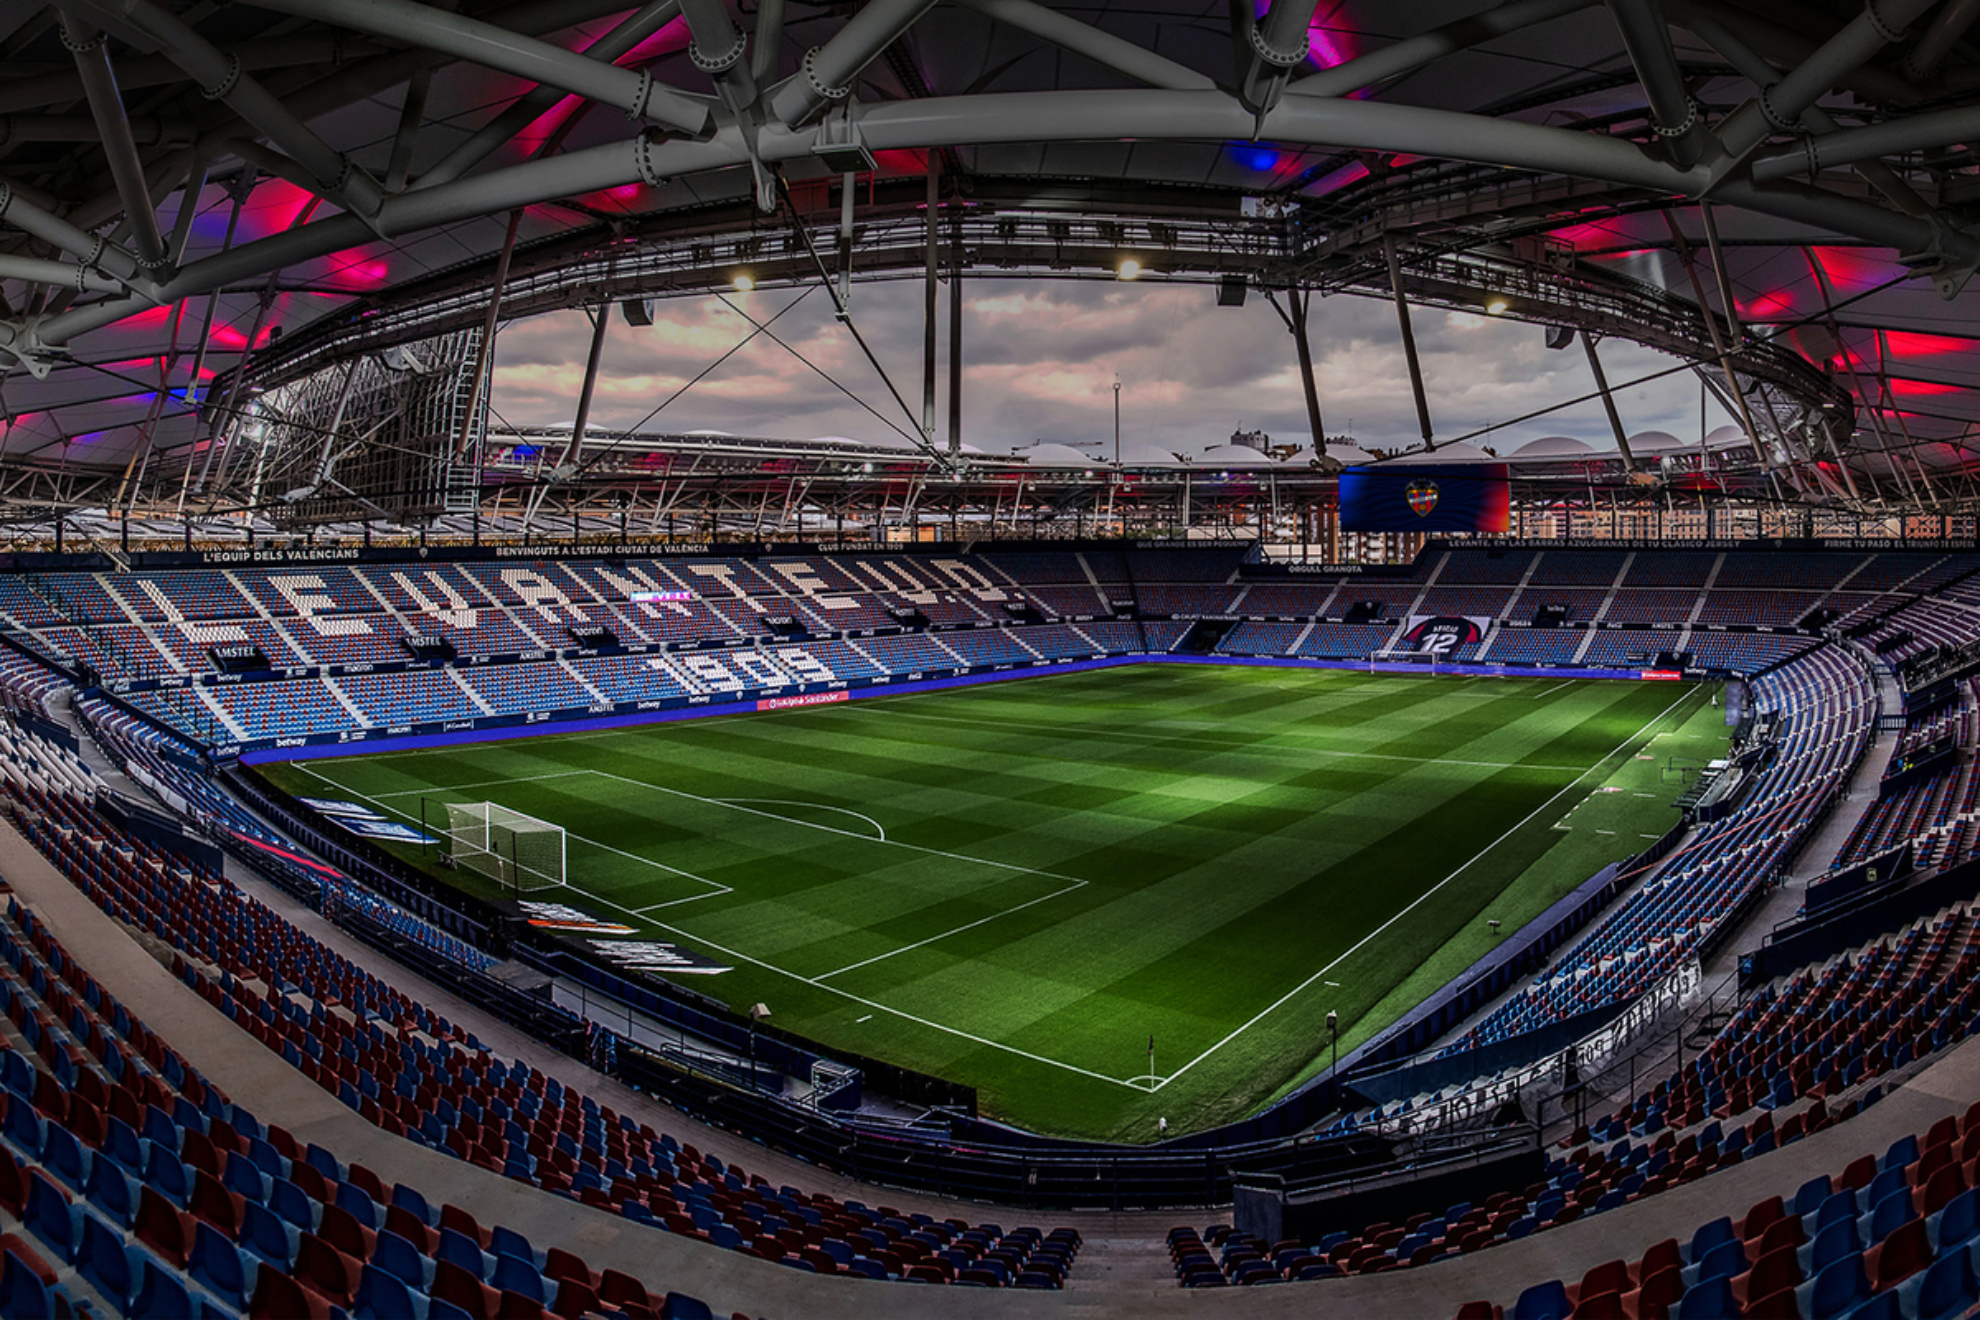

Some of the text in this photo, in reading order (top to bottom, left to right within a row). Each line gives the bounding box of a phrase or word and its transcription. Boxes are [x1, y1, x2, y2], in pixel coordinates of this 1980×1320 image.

[818, 542, 839, 552] CLUB
[841, 542, 872, 550] FUNDAT
[1154, 540, 1185, 548] GRANDE
[1632, 540, 1645, 548] DE
[1647, 540, 1659, 548] TU
[1706, 540, 1740, 548] JERSEY
[1824, 540, 1976, 548] FIRME TU PASO EL TRIUNFO TE ESPERA
[204, 549, 358, 562] L'EQUIP DELS VALENCIANS
[496, 547, 559, 556] BENVINGUTS
[562, 547, 569, 555] A
[572, 546, 613, 556] L'ESTADI
[615, 546, 648, 554] CIUTAT
[650, 546, 662, 554] DE
[1288, 566, 1363, 574] ORGULL GRANOTA
[137, 562, 861, 643] LEVANTE
[1420, 633, 1458, 653] 12
[344, 664, 373, 672] macron
[276, 738, 307, 748] betway
[217, 746, 241, 756] betway
